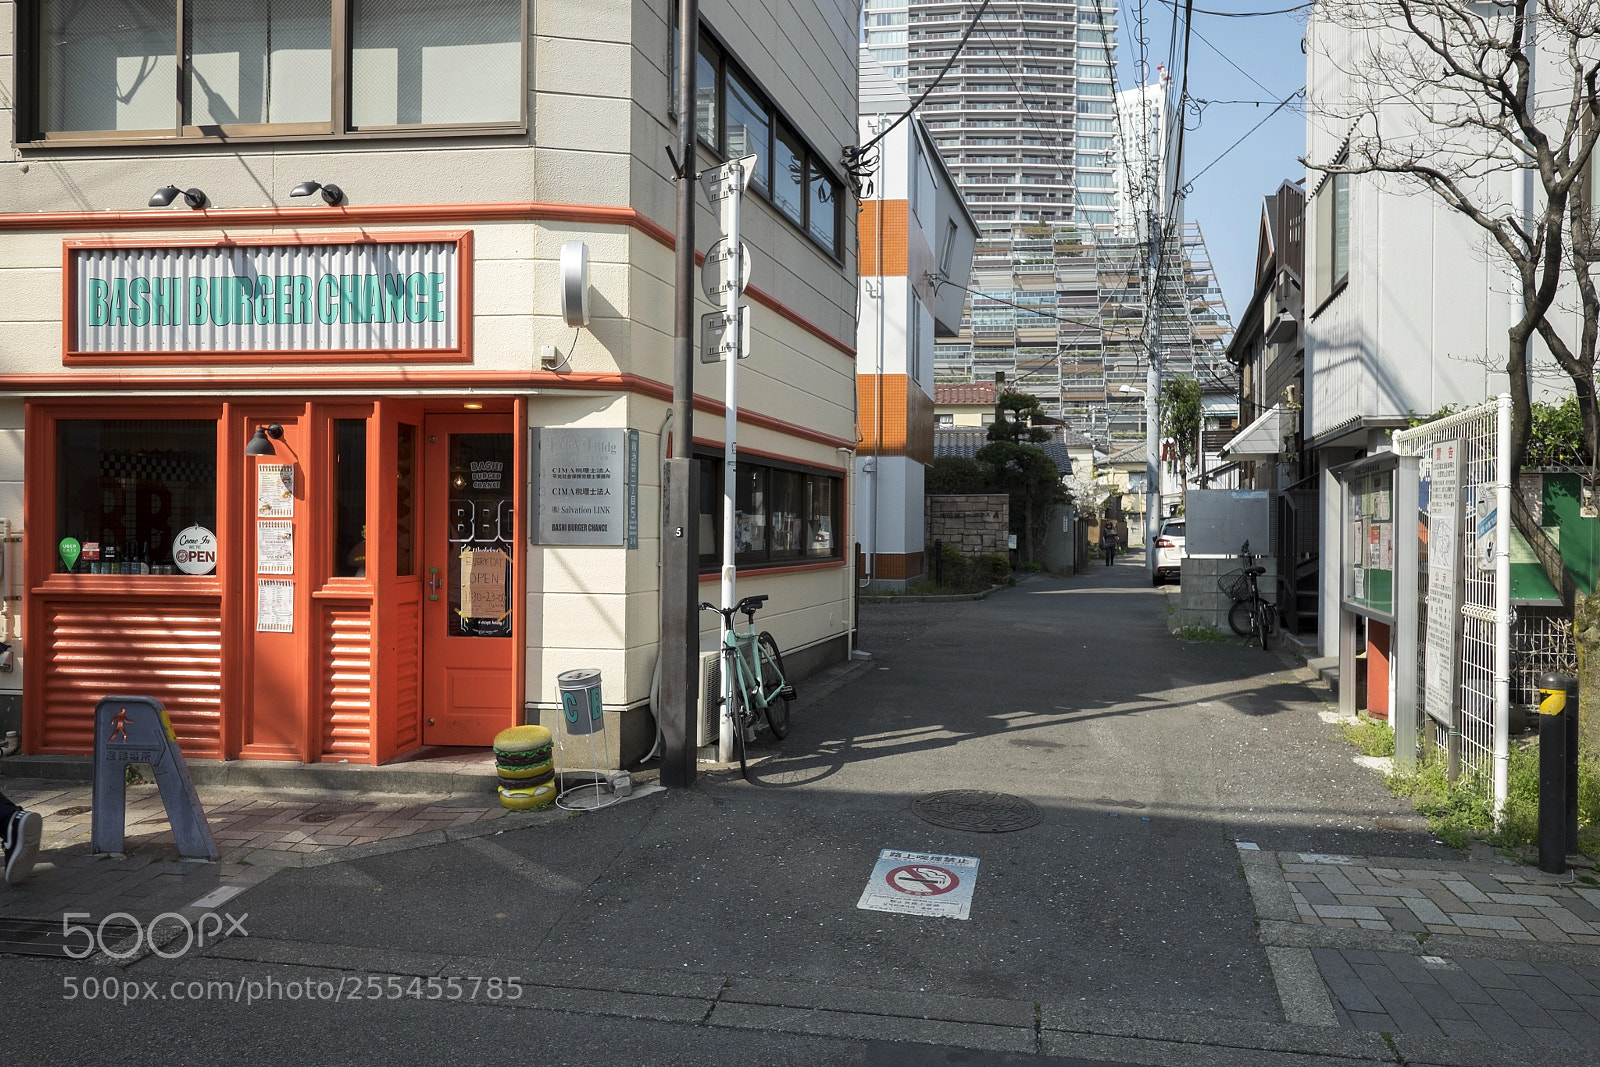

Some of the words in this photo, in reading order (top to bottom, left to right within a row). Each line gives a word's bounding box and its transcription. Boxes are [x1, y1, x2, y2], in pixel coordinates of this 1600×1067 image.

[89, 276, 182, 327] BASHI
[188, 274, 313, 326] BURGER
[318, 271, 444, 325] CHANCE
[470, 461, 503, 472] BASHI
[472, 472, 502, 480] BURGER
[473, 481, 501, 489] CHANCE
[561, 505, 592, 514] Salvation
[593, 505, 611, 514] LINK
[552, 524, 567, 532] BASHI
[568, 524, 587, 532] BURGER
[588, 524, 608, 532] CHANCE
[675, 527, 682, 537] 5
[179, 534, 198, 546] Come
[200, 535, 210, 544] In
[175, 549, 216, 563] OPEN
[470, 572, 499, 585] OPEN
